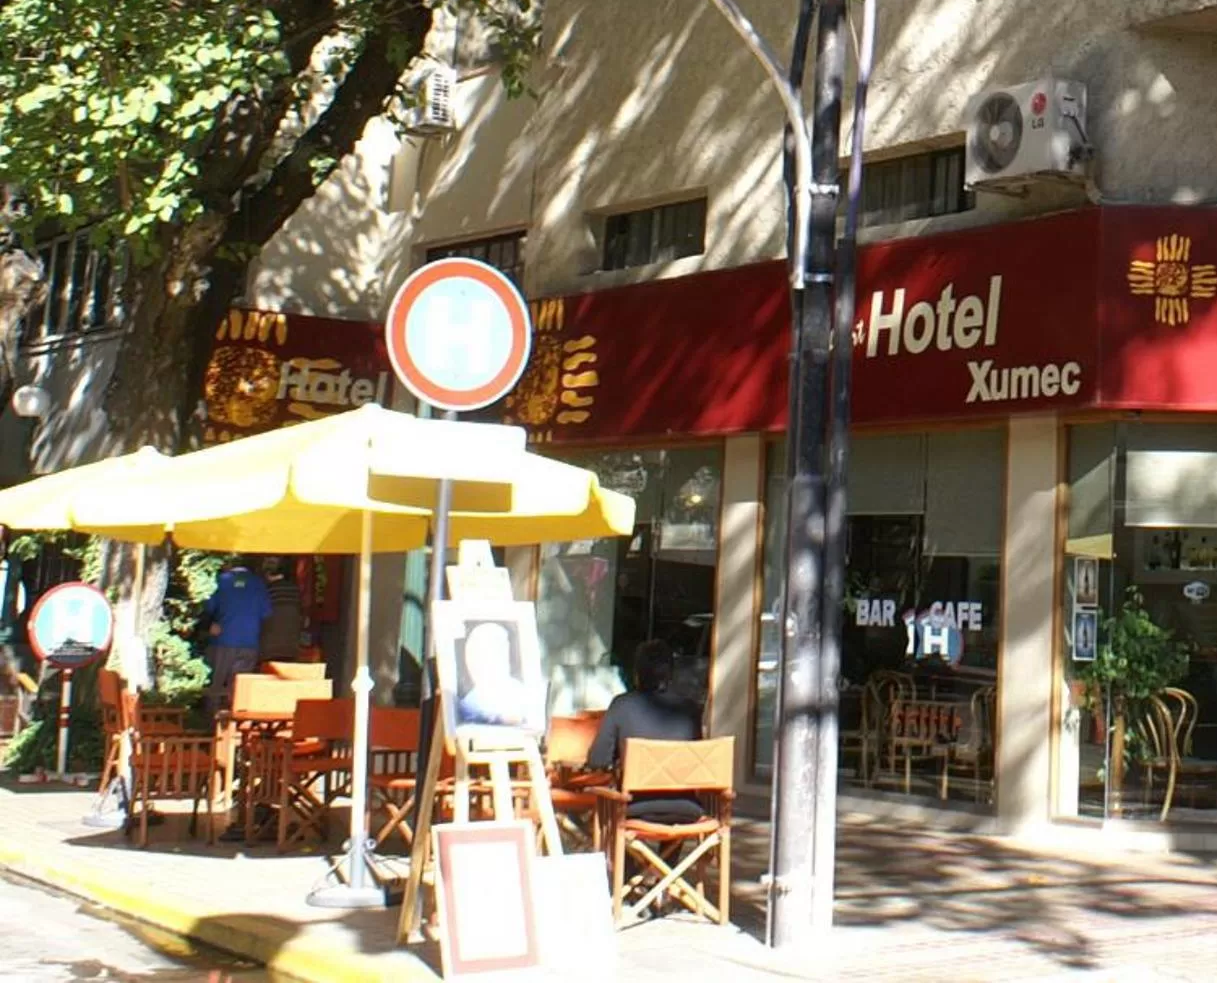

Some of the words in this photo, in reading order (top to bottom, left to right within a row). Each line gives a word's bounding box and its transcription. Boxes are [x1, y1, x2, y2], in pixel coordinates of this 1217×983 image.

[426, 295, 493, 374] H
[866, 274, 1002, 358] Hotel
[275, 360, 387, 405] Hotel
[966, 360, 1081, 403] Xumec
[856, 599, 896, 627] BAR
[930, 601, 982, 631] CAFE
